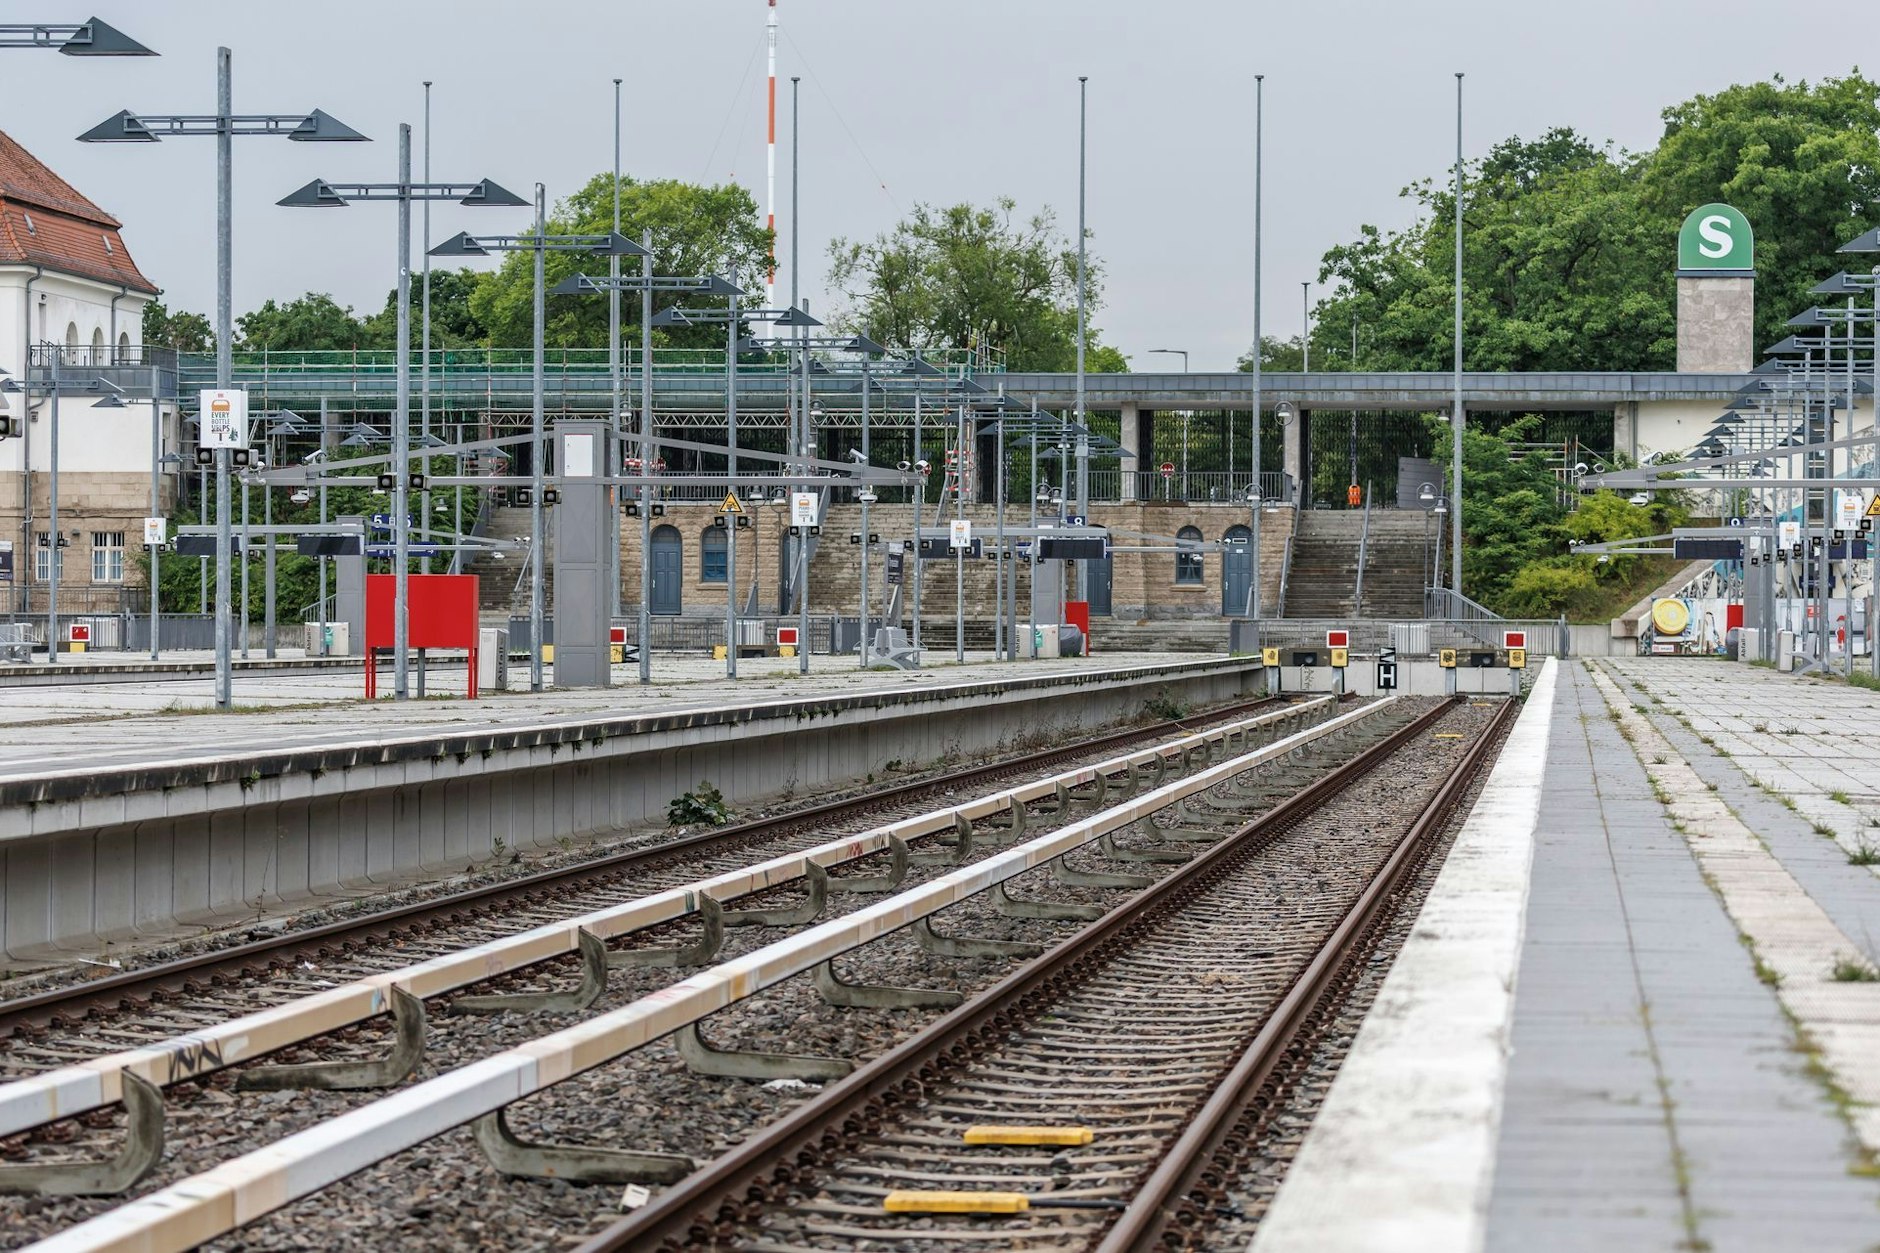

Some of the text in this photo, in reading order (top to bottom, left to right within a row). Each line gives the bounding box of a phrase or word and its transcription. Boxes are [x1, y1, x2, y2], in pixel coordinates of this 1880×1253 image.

[1698, 215, 1734, 259] S
[373, 514, 383, 529] 5
[1379, 665, 1395, 687] H
